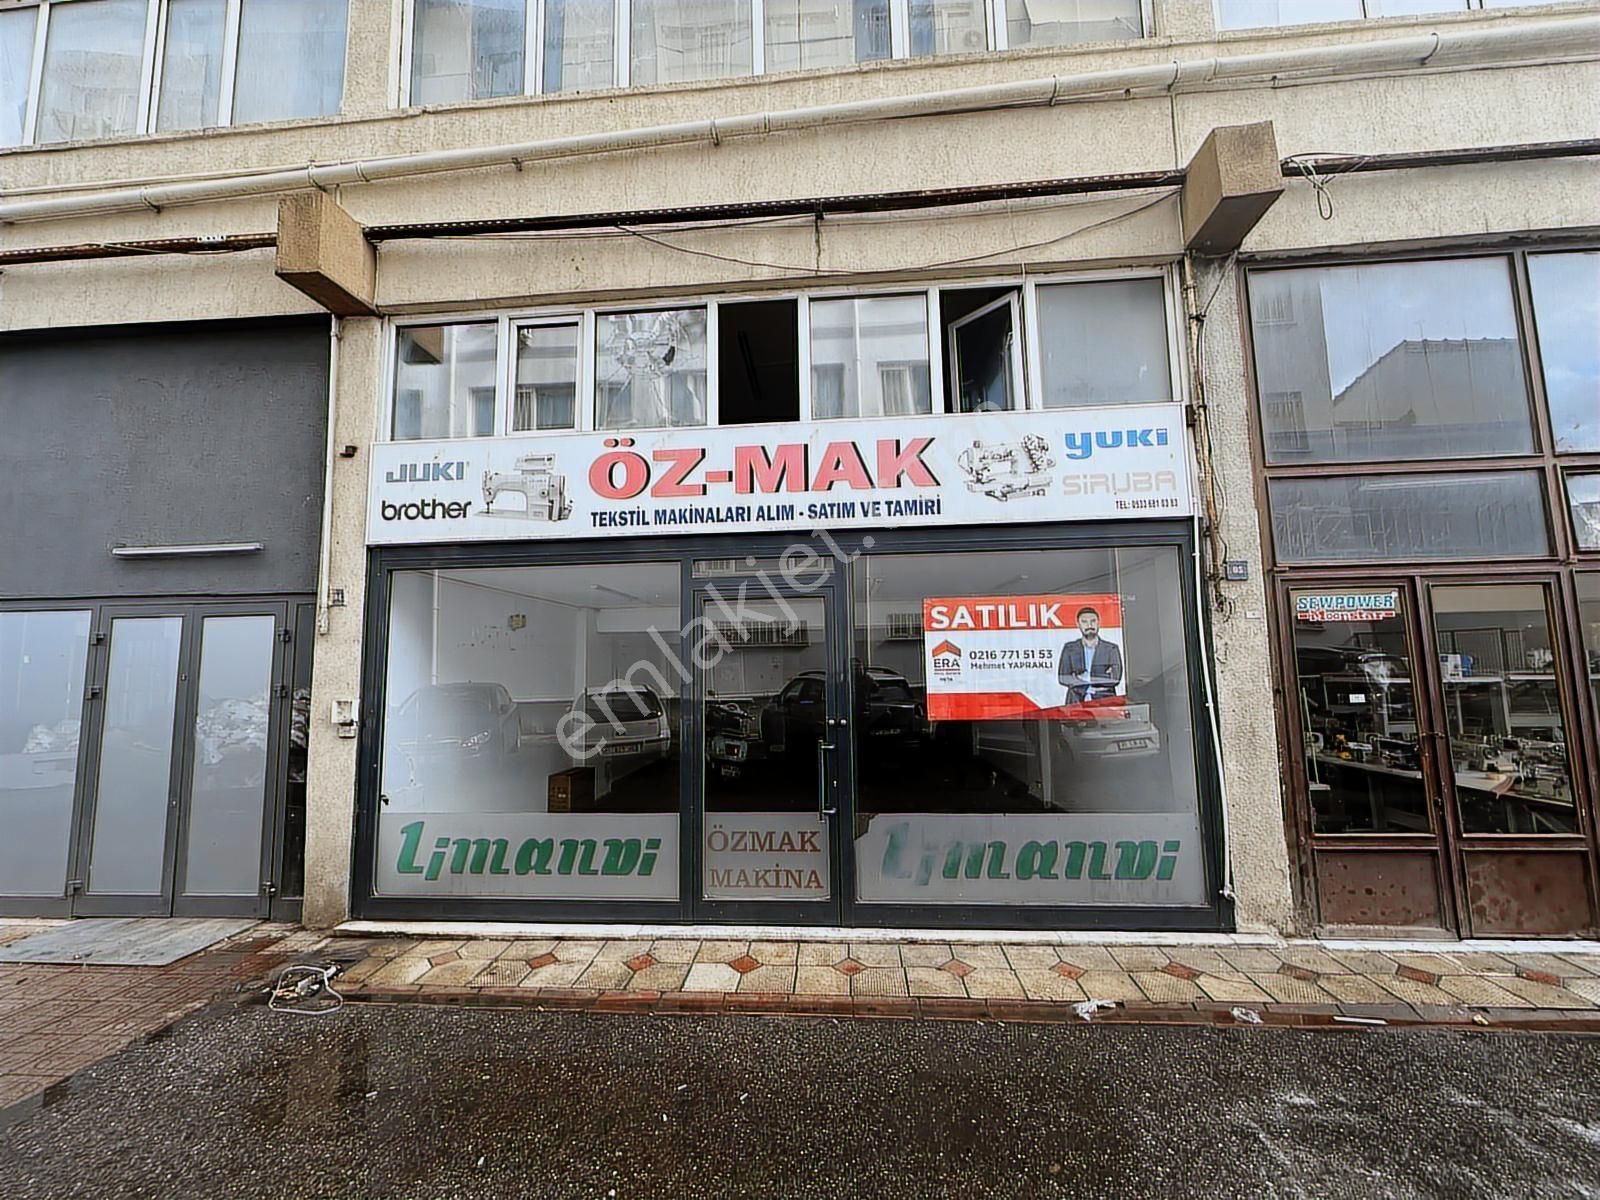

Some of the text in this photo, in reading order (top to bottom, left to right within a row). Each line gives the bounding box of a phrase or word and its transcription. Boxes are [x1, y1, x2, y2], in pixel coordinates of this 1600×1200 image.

[386, 462, 463, 482] JUKI
[588, 438, 942, 499] ÖZ-MAK
[381, 497, 472, 521] brother
[590, 507, 650, 528] TEKSTİL
[654, 503, 752, 525] MAKİNALARI
[756, 503, 795, 521] ALIM
[808, 503, 855, 519] SATIM
[860, 501, 881, 517] VE
[885, 493, 942, 517] TAMİRİ
[931, 602, 1064, 629] SATILIK
[933, 657, 961, 668] ERA
[969, 649, 1053, 660] 0216 771 51 53
[707, 823, 821, 853] ÖZMAK
[709, 862, 824, 889] MAKİNA
